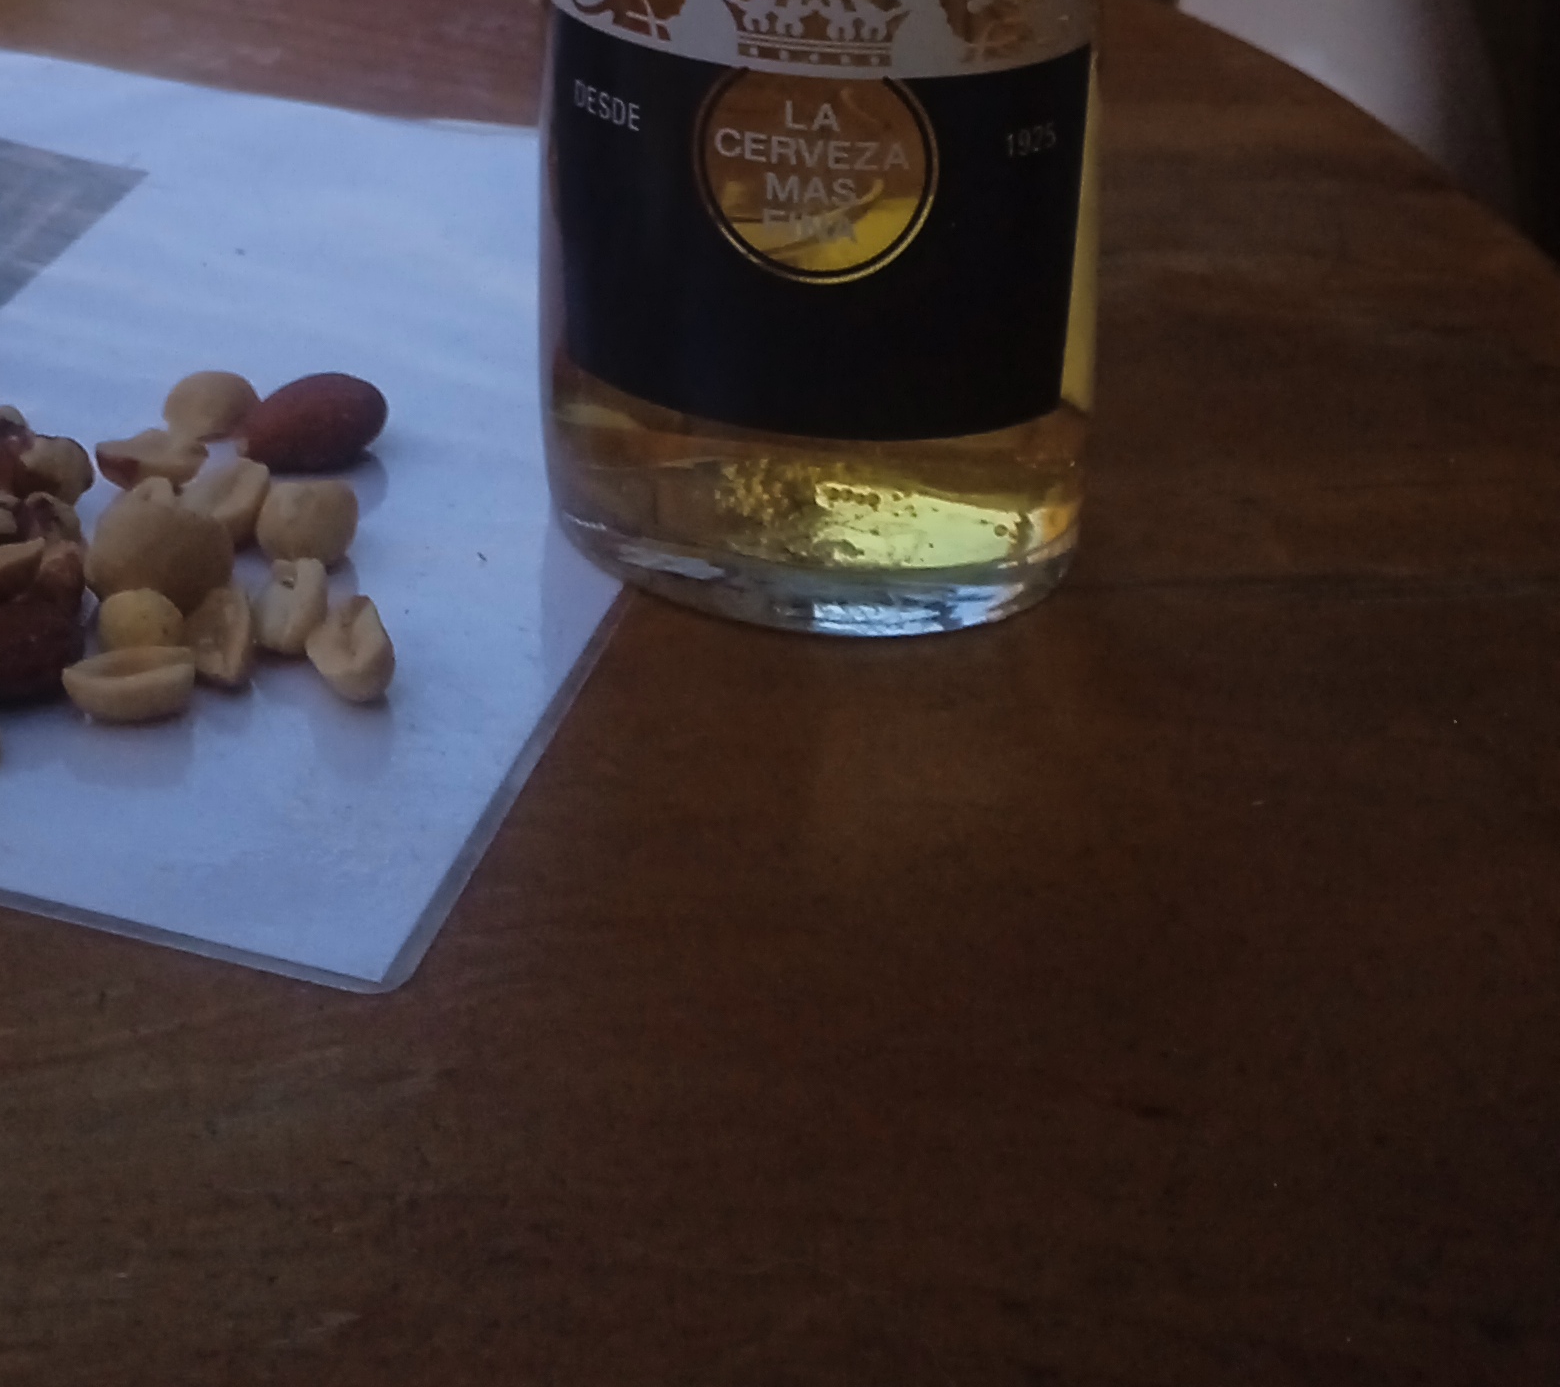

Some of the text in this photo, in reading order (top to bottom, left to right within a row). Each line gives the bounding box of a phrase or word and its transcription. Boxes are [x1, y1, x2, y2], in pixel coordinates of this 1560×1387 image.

[573, 79, 640, 131] DESDE
[784, 100, 840, 131] LA
[714, 129, 911, 171] CERVEZA
[765, 172, 857, 205] MAS
